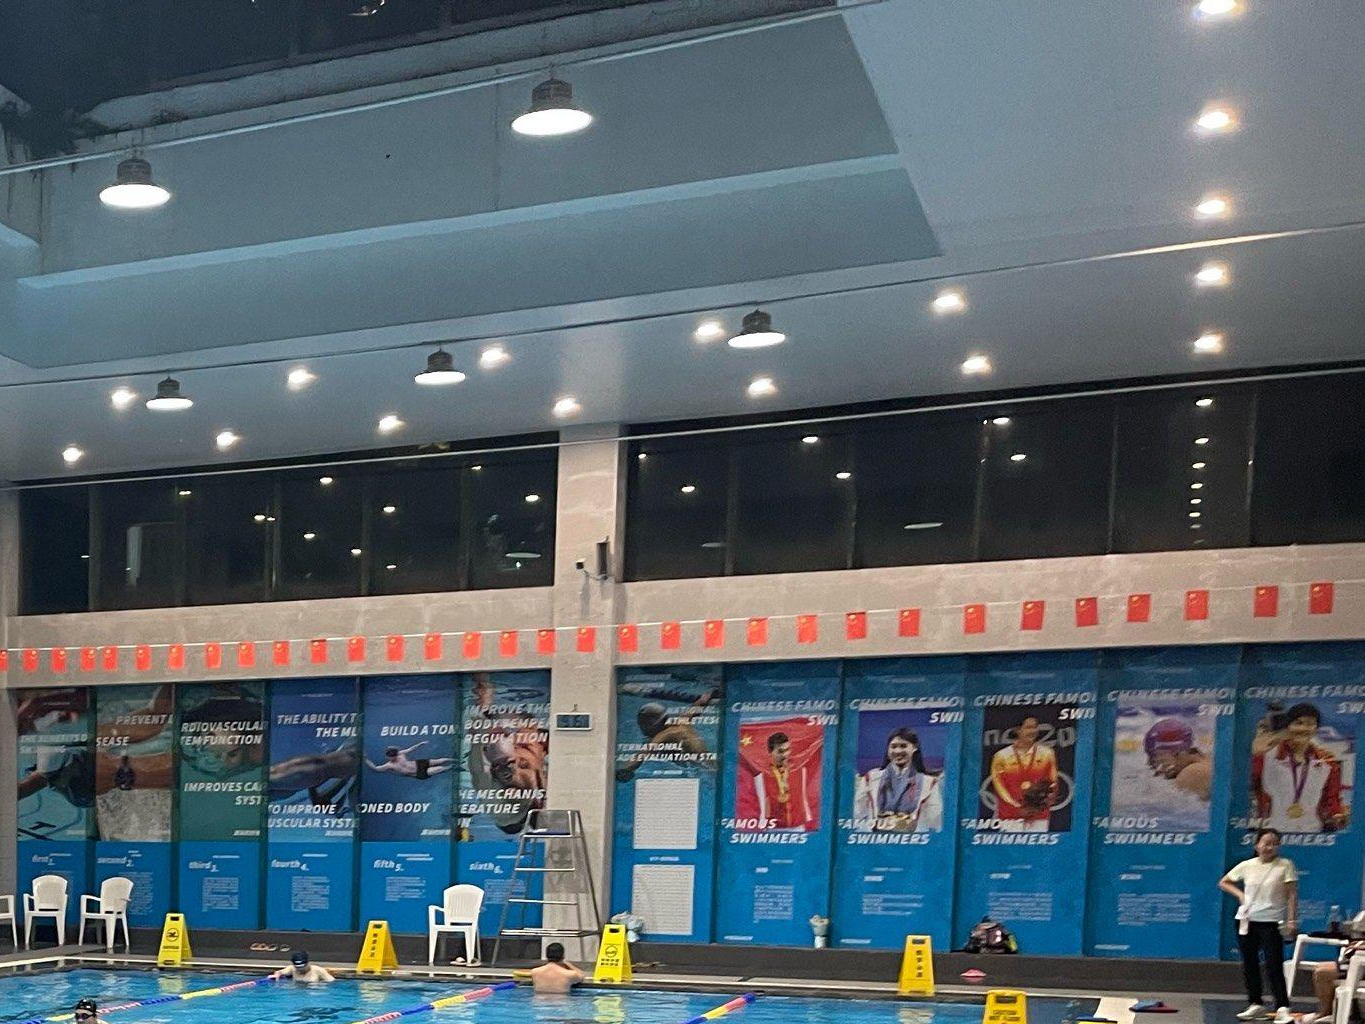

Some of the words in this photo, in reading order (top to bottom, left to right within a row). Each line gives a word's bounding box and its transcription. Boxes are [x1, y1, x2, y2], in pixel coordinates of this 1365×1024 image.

[973, 694, 1044, 706] CHINESE
[465, 703, 524, 715] IMPROVE
[731, 701, 793, 713] CHINESE
[115, 714, 165, 726] PREVENT
[277, 714, 300, 725] THE
[300, 713, 348, 724] ABILITY
[464, 718, 498, 731] BODY
[315, 727, 339, 738] THE
[379, 725, 420, 737] BUILD
[420, 725, 431, 736] A
[202, 734, 262, 745] FUNCTION
[464, 732, 548, 744] REGULATION
[638, 753, 696, 763] EVALUATION
[183, 782, 243, 793] IMPROVES
[282, 803, 337, 816] IMPROVE
[393, 802, 431, 814] BODY
[729, 832, 809, 845] SWIMMERS
[847, 832, 931, 845] SWIMMERS
[971, 833, 1061, 846] SWIMMERS
[1104, 832, 1197, 845] SWIMMERS
[271, 859, 301, 868] fourth
[374, 859, 395, 868] fifth
[469, 861, 494, 870] sixth
